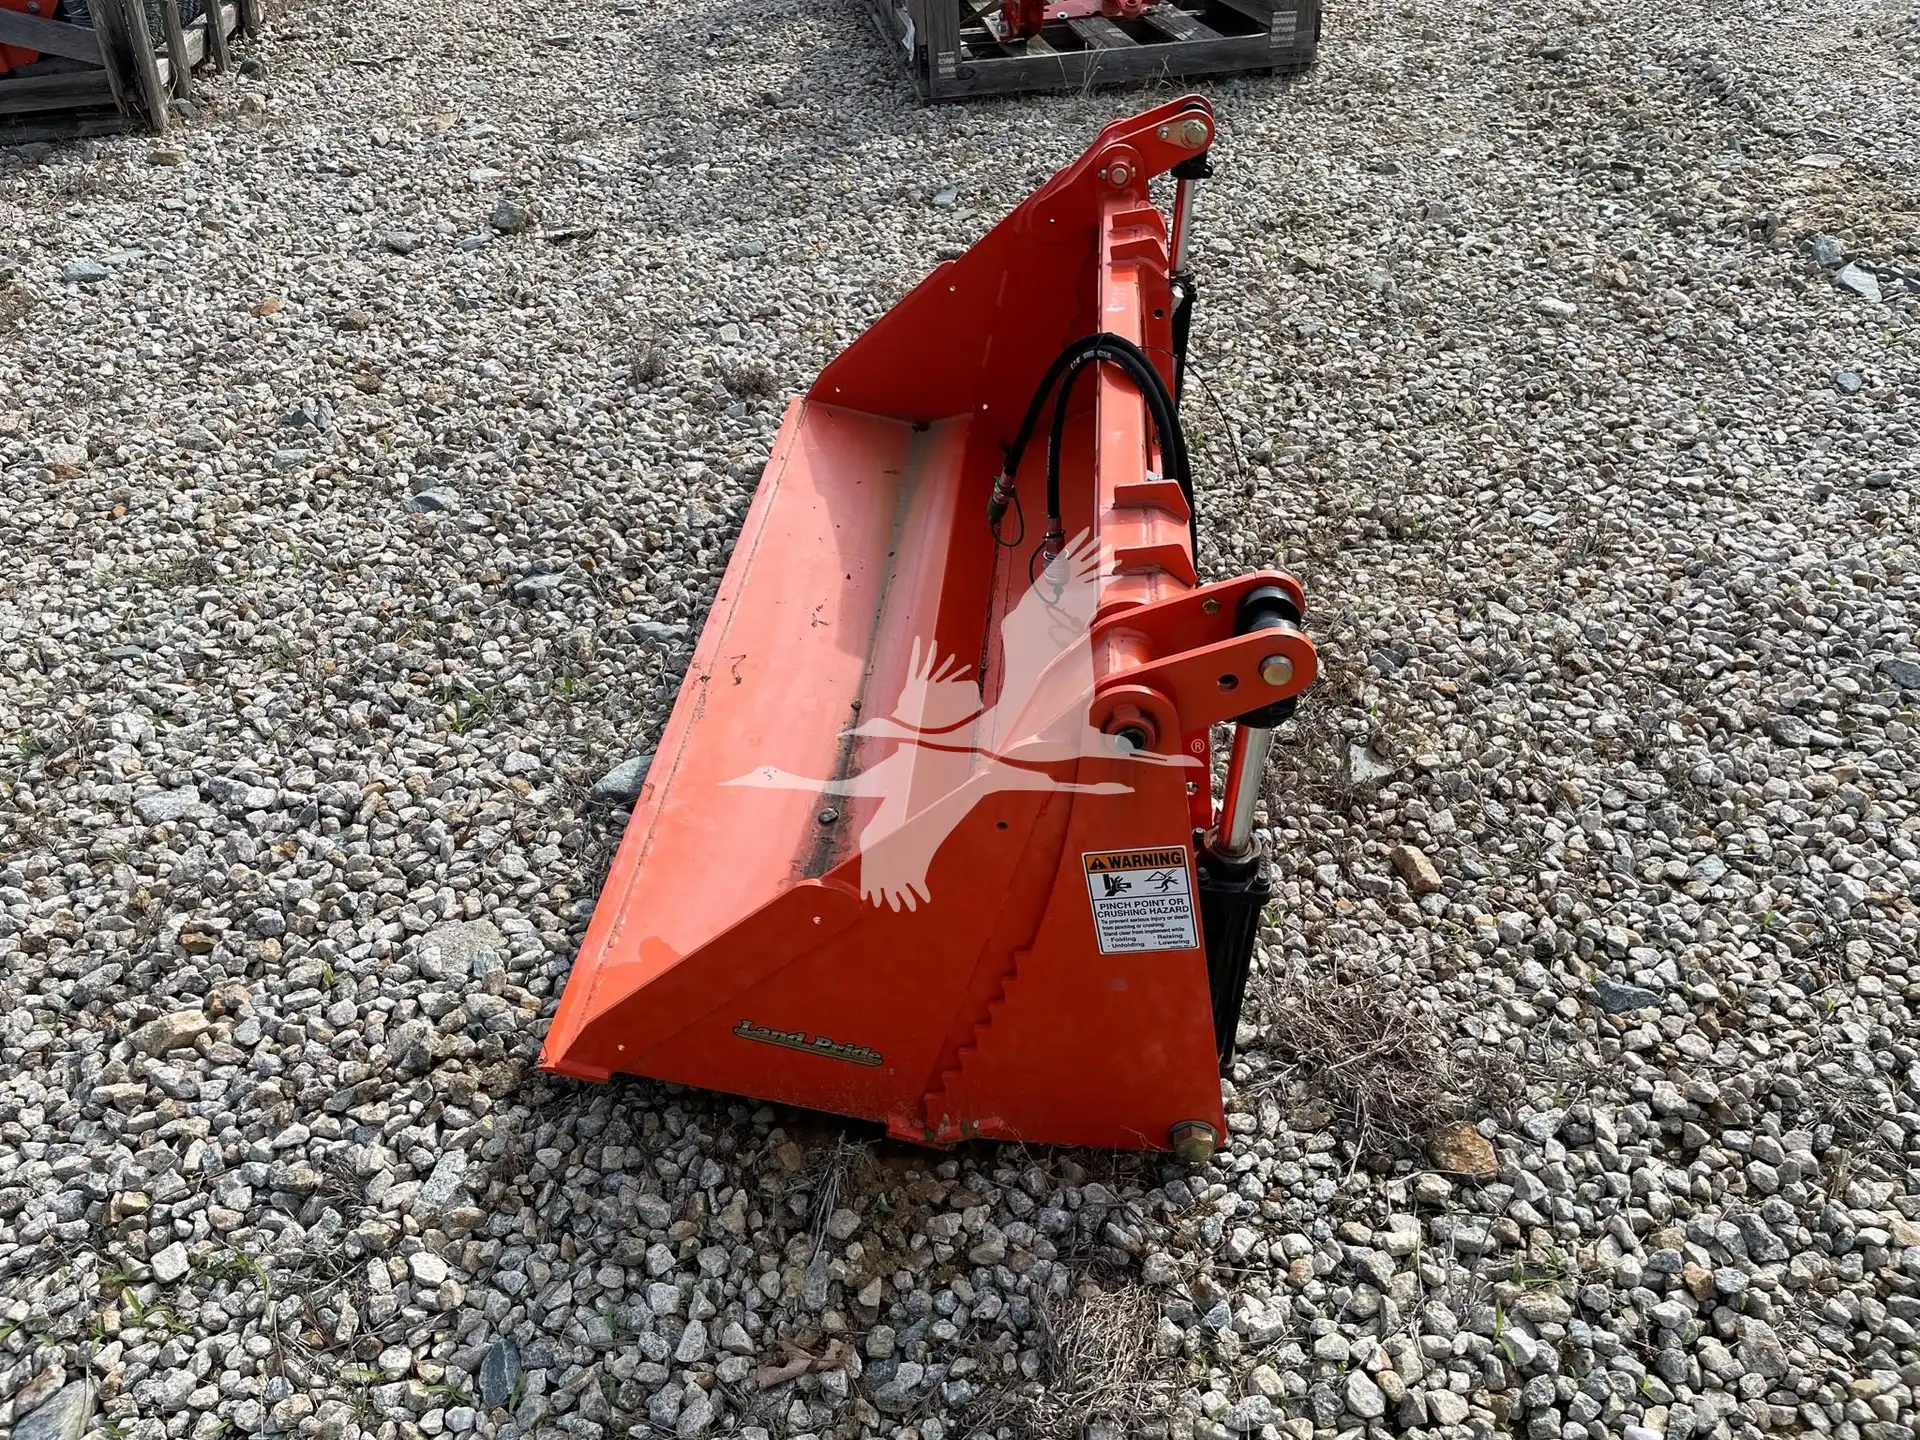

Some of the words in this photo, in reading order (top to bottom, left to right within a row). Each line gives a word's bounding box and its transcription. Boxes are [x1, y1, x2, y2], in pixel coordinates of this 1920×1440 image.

[1108, 852, 1182, 868] WARNING
[1097, 908, 1147, 918] CRUSHING
[1150, 906, 1189, 914] HAZARD
[1100, 902, 1131, 910] PINCH
[1134, 900, 1165, 908] POINT
[737, 1020, 806, 1045] Land
[810, 1035, 882, 1061] Pride
